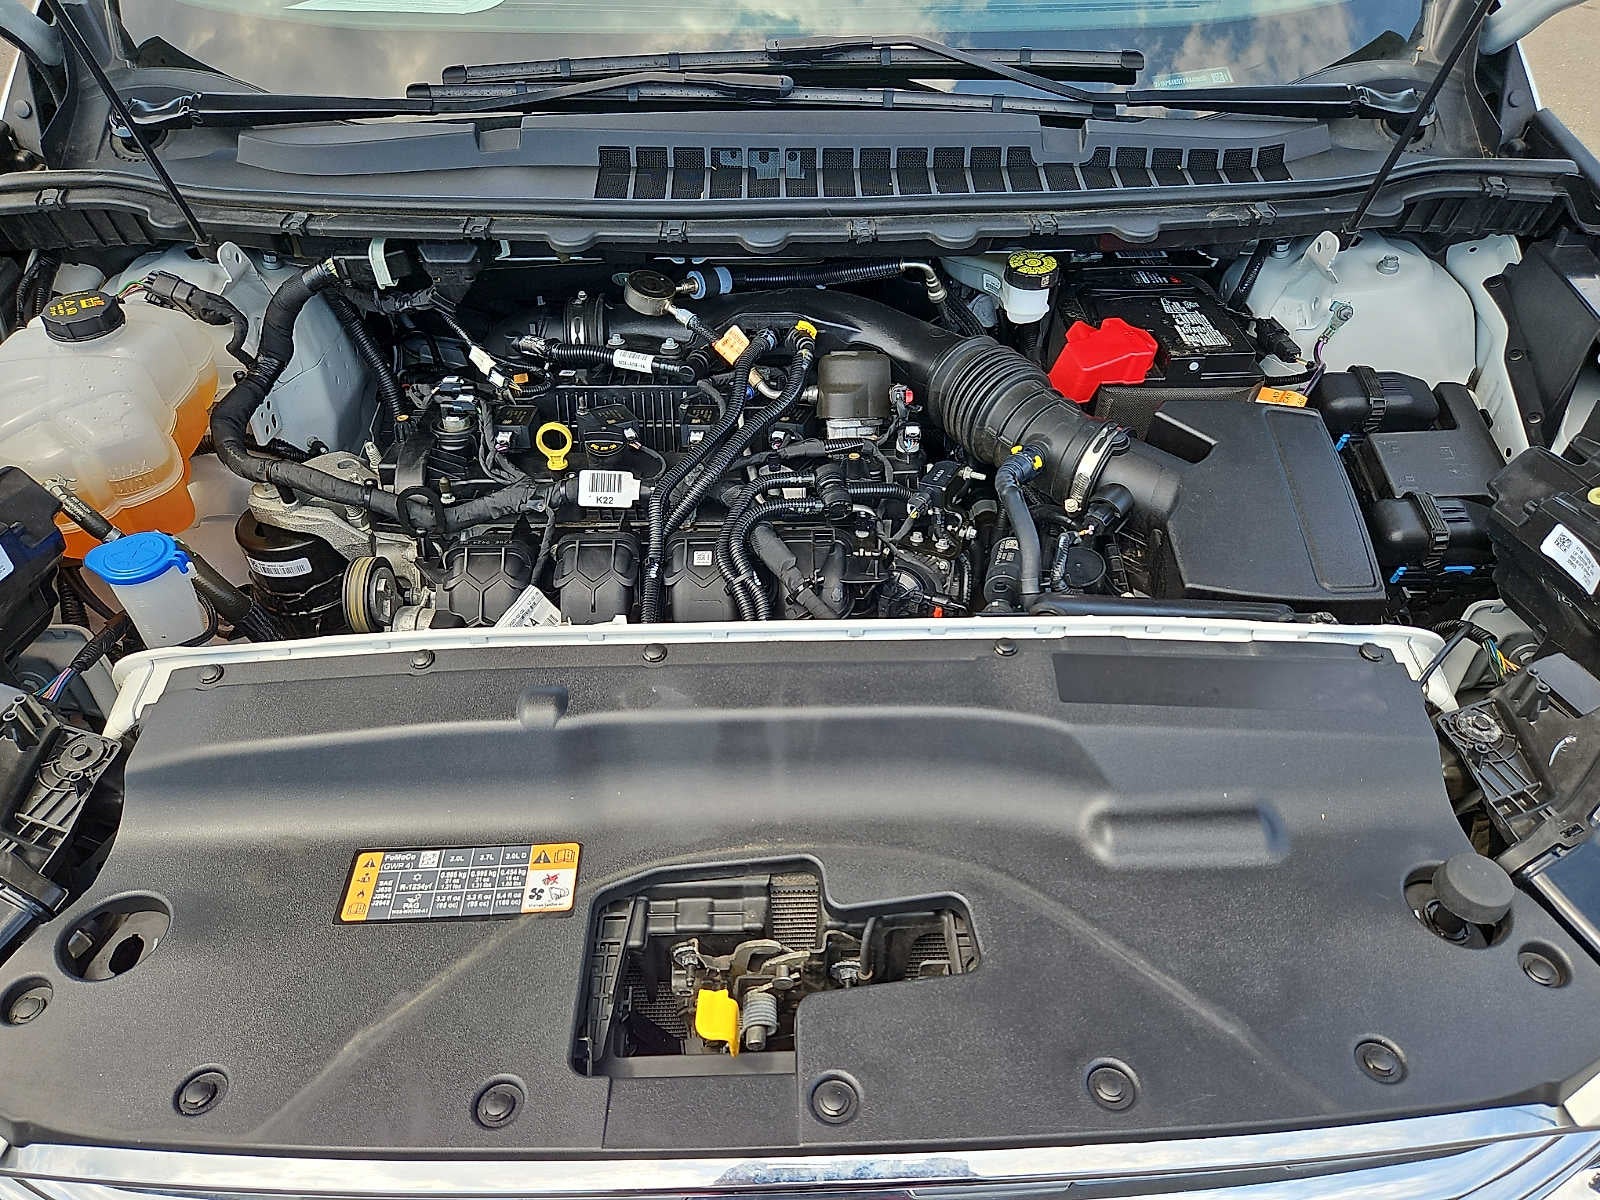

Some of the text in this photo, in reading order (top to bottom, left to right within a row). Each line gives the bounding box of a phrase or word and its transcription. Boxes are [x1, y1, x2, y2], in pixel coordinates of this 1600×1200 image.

[596, 495, 614, 505] K22
[384, 853, 416, 861] FoMoCo
[459, 871, 467, 879] kg
[489, 870, 497, 878] kg
